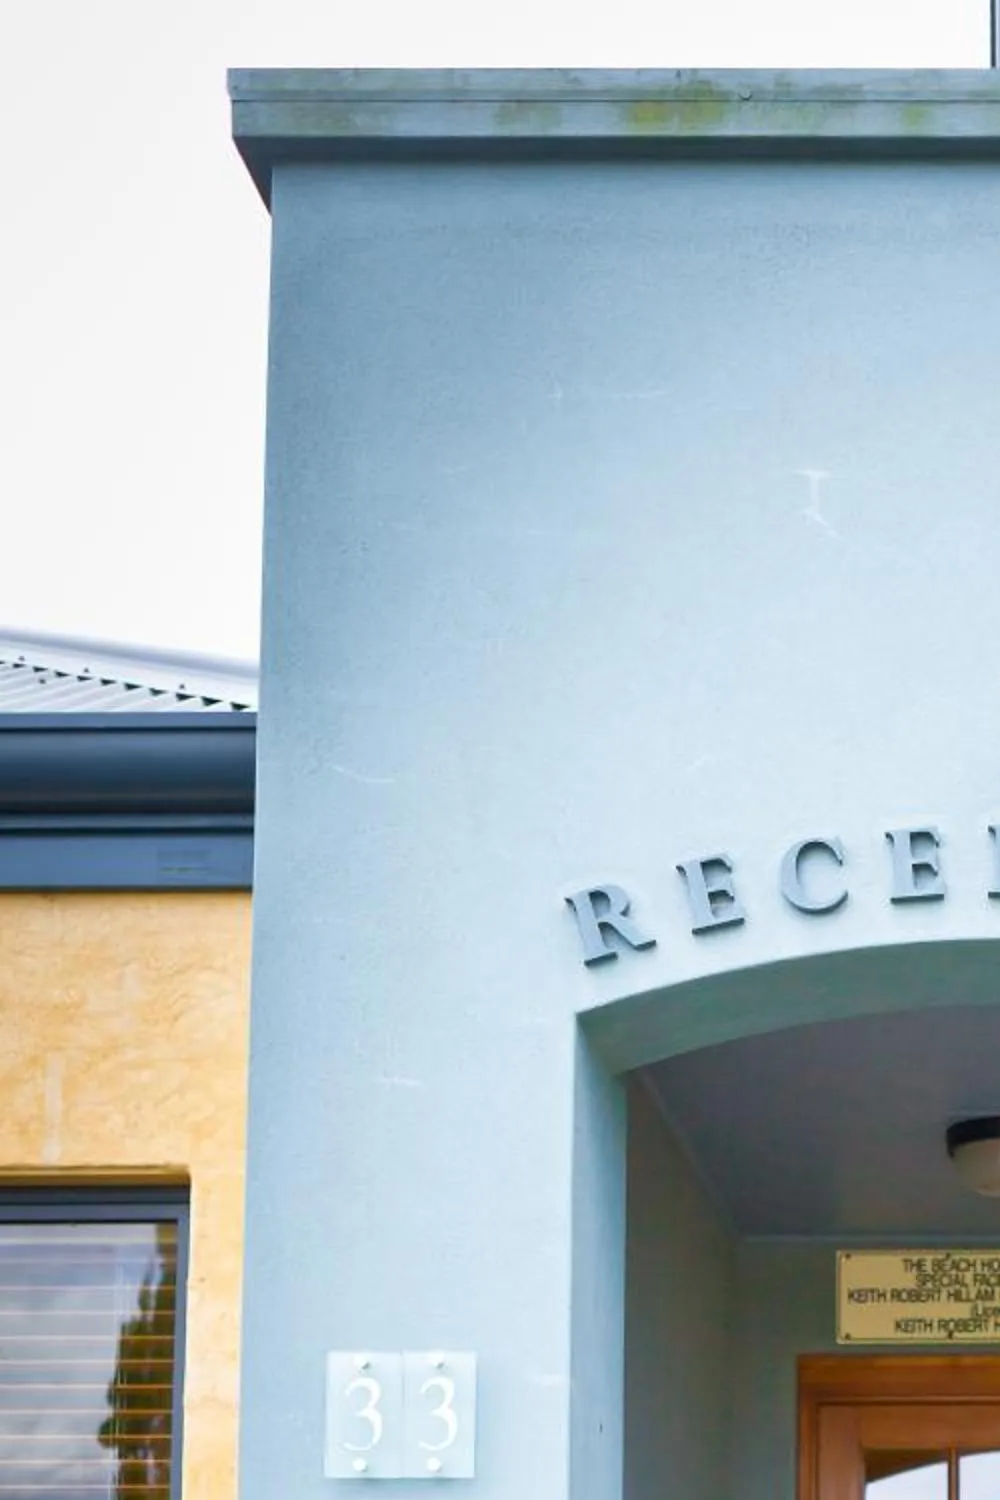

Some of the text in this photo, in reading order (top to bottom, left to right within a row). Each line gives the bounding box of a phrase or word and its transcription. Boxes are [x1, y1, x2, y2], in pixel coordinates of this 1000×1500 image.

[903, 1258, 928, 1273] THE
[931, 1258, 976, 1273] BEACH
[915, 1273, 968, 1288] SPECIAL
[848, 1287, 886, 1303] KEITH
[890, 1287, 943, 1303] ROBERT
[947, 1287, 996, 1302] HILLAM
[894, 1317, 933, 1333] KEITH
[936, 1317, 990, 1332] ROBERT
[343, 1376, 458, 1451] 33
